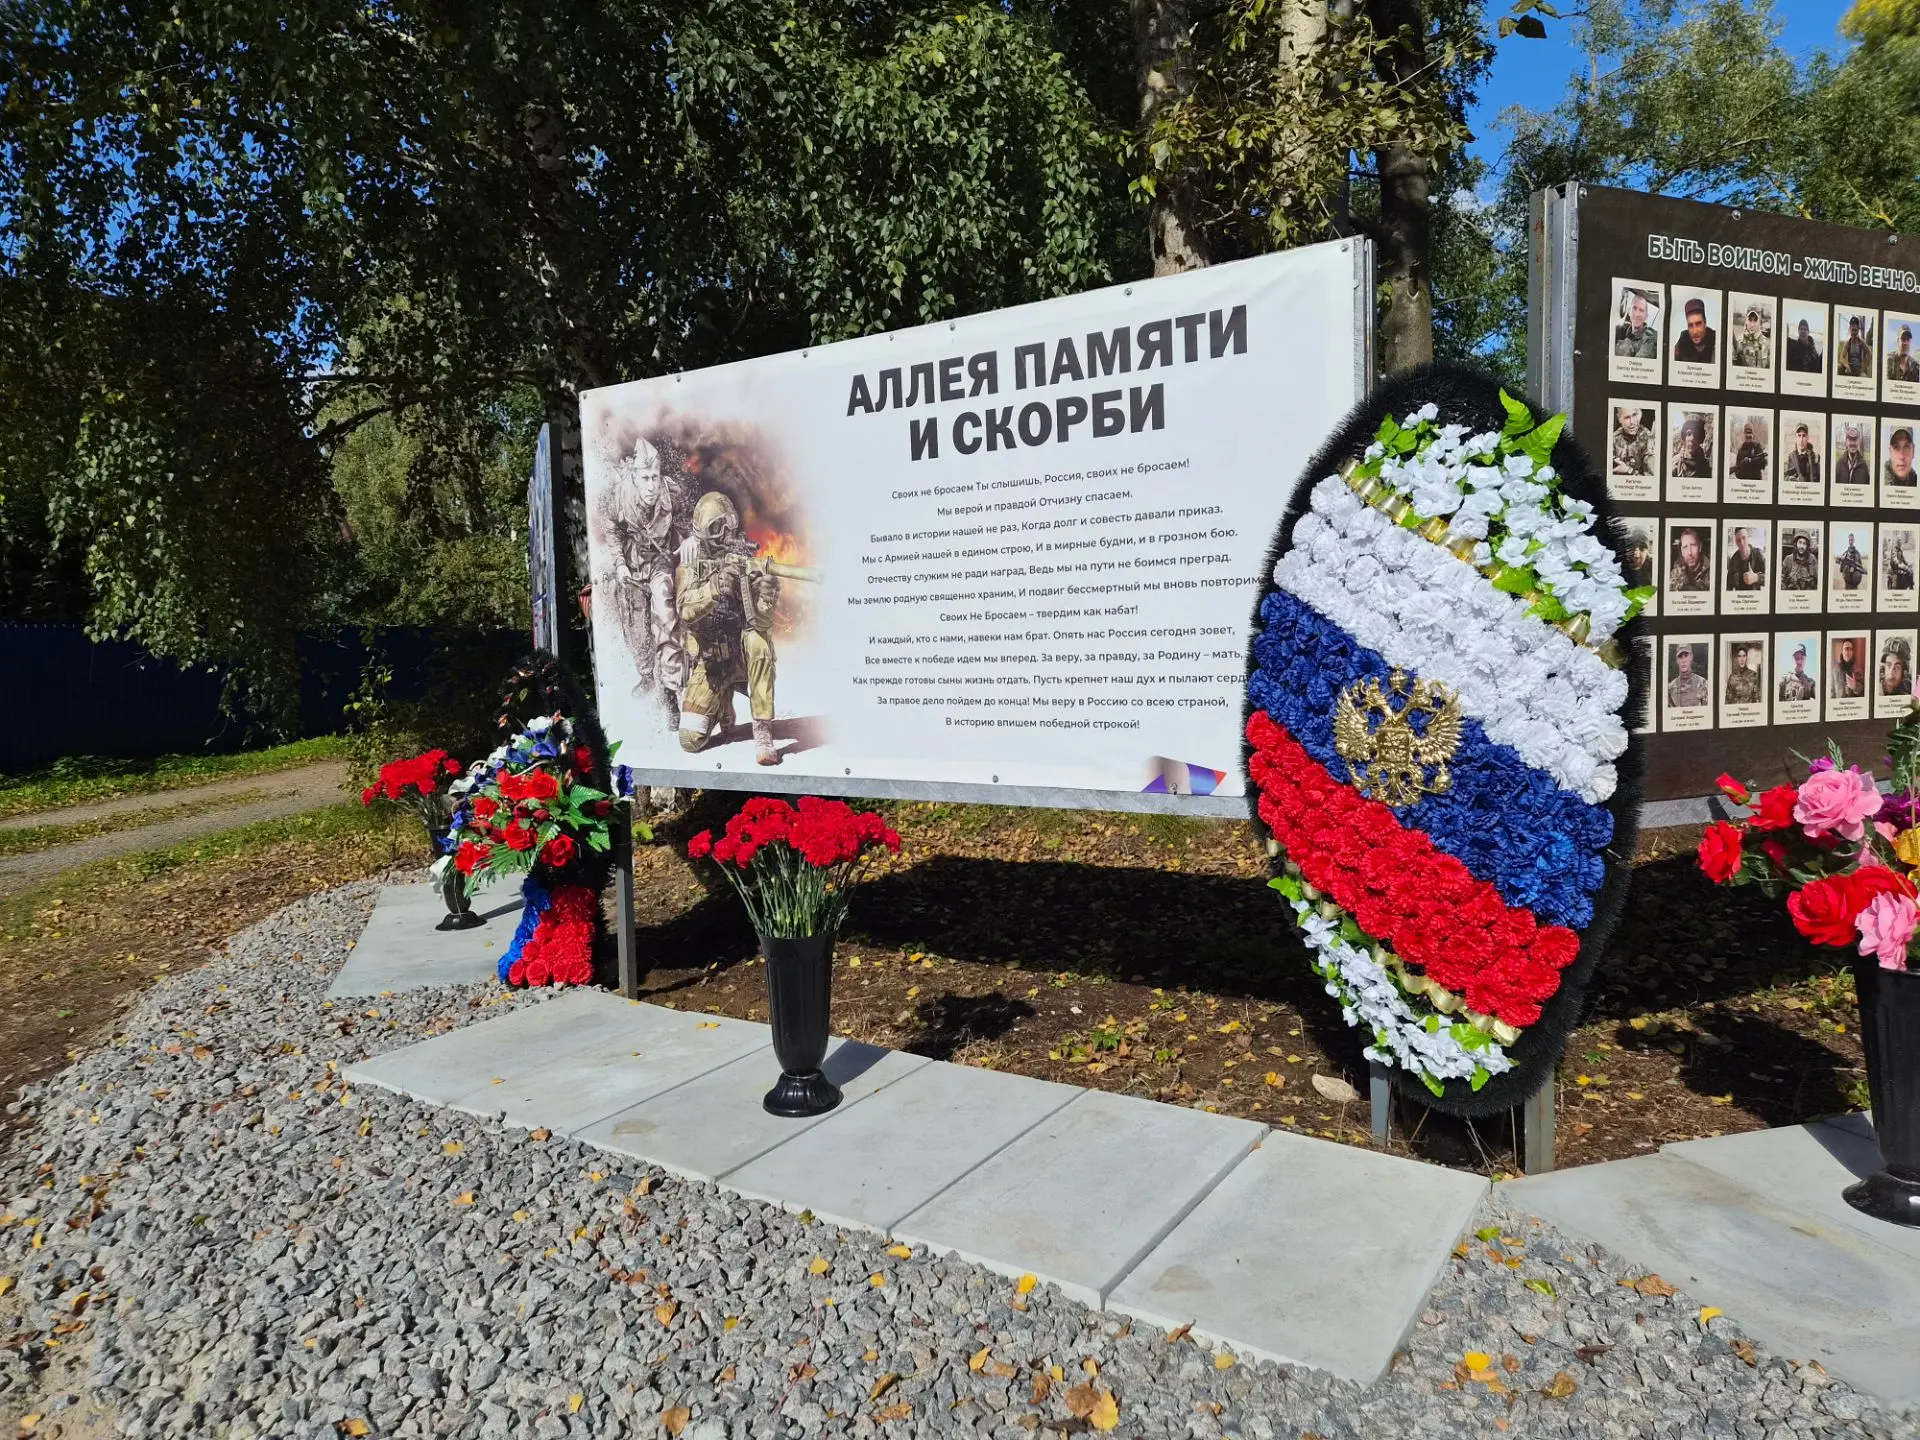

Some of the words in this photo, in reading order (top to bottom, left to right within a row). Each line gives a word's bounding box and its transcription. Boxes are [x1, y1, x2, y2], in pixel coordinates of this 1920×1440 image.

[1648, 234, 1704, 264] БЫТЬ
[1708, 243, 1791, 276] ВОИНОМ
[1804, 256, 1857, 285] ЖИТЬ
[846, 350, 999, 416] АЛЛЕЯ
[1014, 304, 1248, 390] ПАМЯТИ
[909, 417, 939, 461] И
[952, 383, 1165, 456] СКОРБИ
[891, 490, 918, 499] Своих
[920, 488, 932, 496] не
[933, 484, 973, 496] бросаем
[975, 481, 989, 490] Ты
[1086, 468, 1118, 478] своих
[1120, 466, 1134, 474] не
[937, 507, 952, 516] Мы
[954, 503, 983, 516] верой
[985, 504, 992, 512] и
[994, 497, 1036, 512] правдой
[1038, 495, 1082, 506] Отчизну
[870, 533, 903, 543] Бывало
[912, 530, 950, 539] истории
[952, 525, 983, 536] нашей
[1021, 521, 1051, 530] Когда
[1053, 518, 1078, 529] долг
[1080, 517, 1087, 526] и
[1089, 513, 1132, 524] совесть
[1134, 509, 1175, 522] давали
[861, 555, 876, 564] Мы
[884, 551, 920, 564] Армией
[921, 549, 952, 559] нашей
[961, 547, 998, 558] едином
[1035, 542, 1043, 551] И
[1045, 543, 1052, 551] в
[1054, 540, 1097, 551] мирные
[1138, 536, 1146, 544] и
[1148, 535, 1155, 543] в
[1158, 531, 1207, 544] грозном
[867, 574, 912, 584] Отечеству
[913, 572, 949, 582] служим
[950, 571, 962, 579] не
[964, 569, 988, 580] ради
[1029, 564, 1054, 575] Ведь
[1056, 564, 1072, 572] мы
[1074, 563, 1087, 571] на
[1090, 561, 1115, 572] пути
[1117, 560, 1131, 568] не
[1134, 557, 1176, 567] боимся
[847, 597, 862, 605] Мы
[863, 596, 892, 604] землю
[893, 594, 928, 605] родную
[929, 592, 976, 601] священно
[1018, 587, 1026, 597] И
[1028, 587, 1065, 597] подвиг
[1066, 581, 1141, 594] бессмертный
[1143, 582, 1160, 590] мы
[1163, 580, 1198, 589] вновь
[939, 612, 968, 621] Своих
[969, 611, 983, 620] Не
[984, 611, 1027, 621] Бросаем
[1036, 609, 1081, 619] твердим
[1083, 608, 1102, 616] как
[868, 636, 875, 644] И
[877, 634, 914, 644] каждый,
[915, 635, 931, 643] кто
[932, 635, 938, 643] с
[967, 634, 1002, 642] навеки
[1003, 633, 1023, 641] нам
[1052, 630, 1084, 640] Опять
[1087, 630, 1105, 639] нас
[1108, 628, 1147, 638] Россия
[1150, 627, 1196, 637] сегодня
[864, 656, 880, 664] Все
[881, 656, 912, 664] вместе
[921, 654, 955, 664] победе
[956, 656, 981, 664] идем
[983, 655, 998, 663] мы
[1040, 653, 1053, 662] За
[1084, 653, 1096, 661] за
[1142, 652, 1155, 660] за
[1157, 650, 1201, 661] Родину
[852, 676, 868, 684] Как
[869, 677, 903, 686] прежде
[1033, 675, 1062, 686] Пусть
[1064, 676, 1109, 685] крепнет
[1111, 675, 1133, 683] наш
[1136, 675, 1155, 685] дух
[1158, 675, 1166, 683] и
[1168, 675, 1214, 683] пылают
[876, 696, 887, 704] За
[889, 697, 920, 706] правое
[921, 697, 945, 706] дело
[946, 695, 982, 706] пойдем
[983, 698, 996, 706] до
[1032, 696, 1049, 705] Мы
[1051, 698, 1076, 708] веру
[1078, 698, 1085, 706] в
[1087, 696, 1128, 706] Россию
[1130, 698, 1144, 706] со
[1146, 698, 1175, 706] всею
[945, 717, 952, 725] В
[954, 719, 995, 728] историю
[996, 719, 1037, 727] впишем
[1039, 718, 1090, 729] победной
